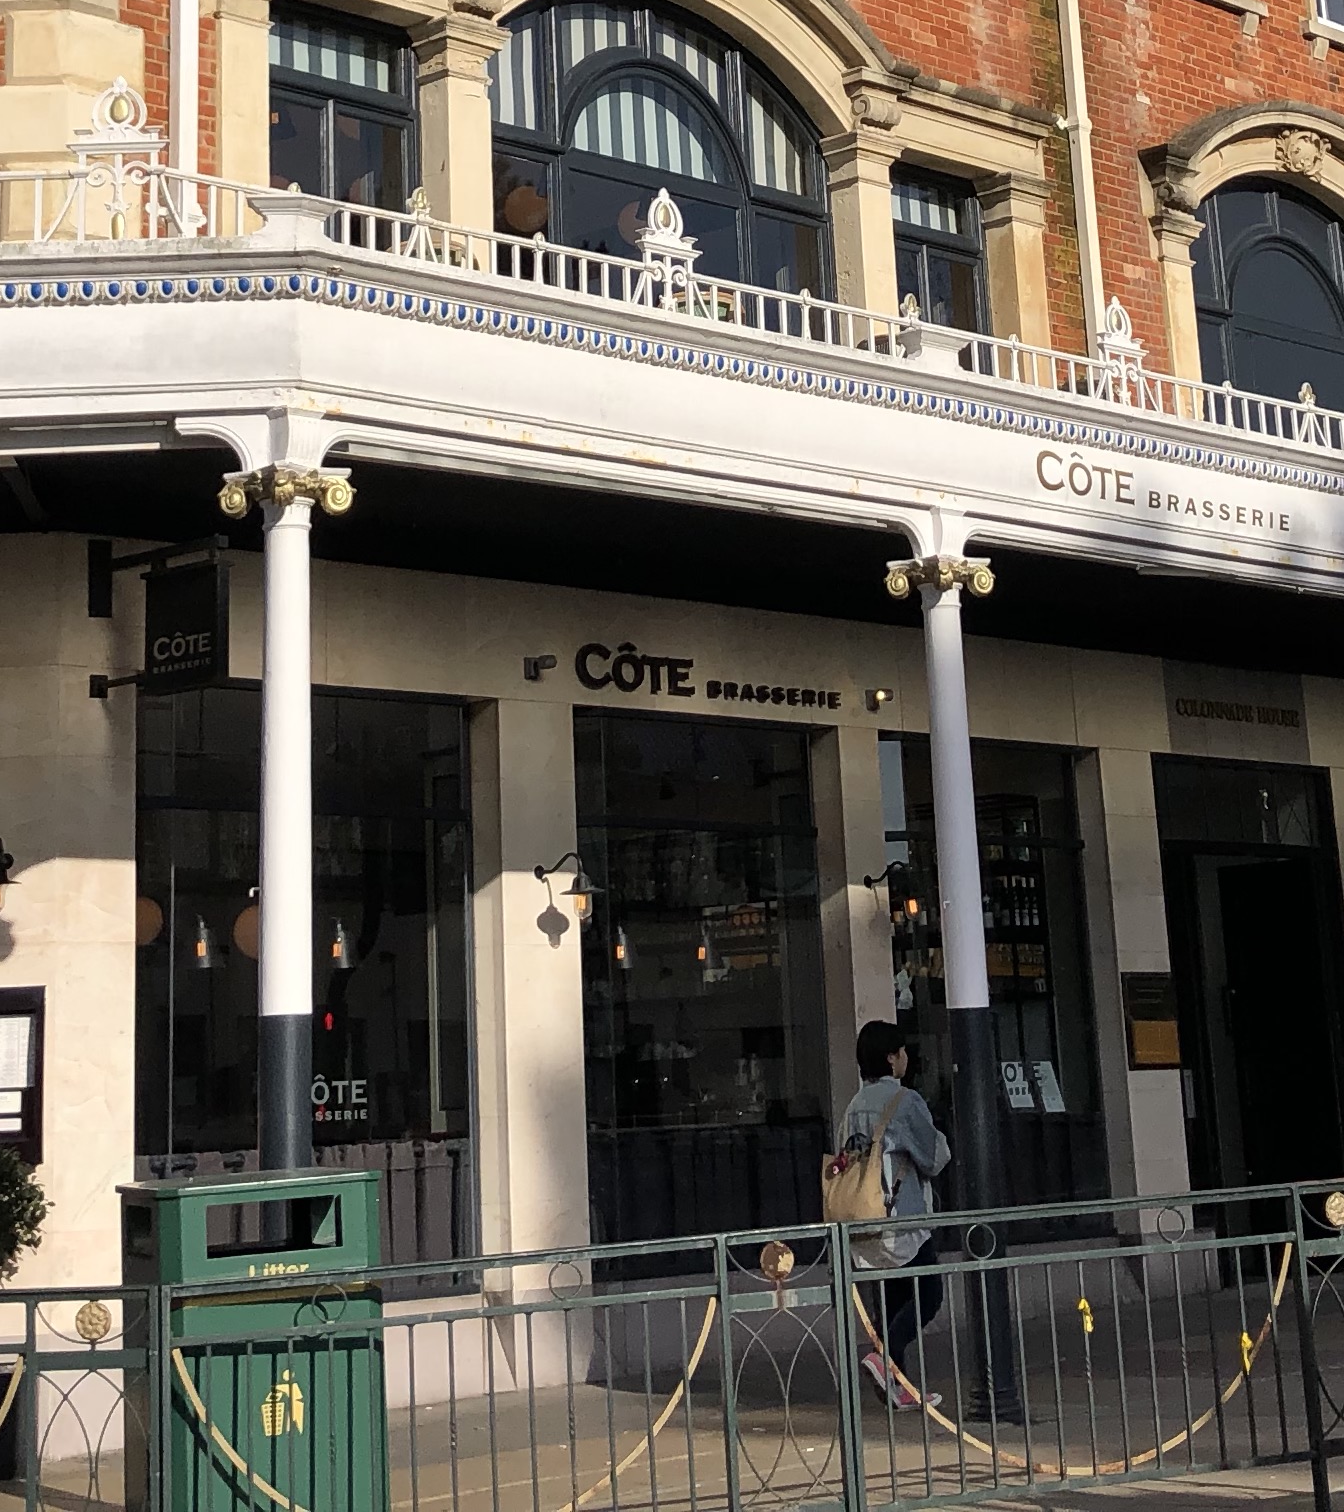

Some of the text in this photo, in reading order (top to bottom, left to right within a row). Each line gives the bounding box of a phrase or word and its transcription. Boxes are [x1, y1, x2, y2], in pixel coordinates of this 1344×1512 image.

[1036, 450, 1291, 532] CÔTE BRASSERIE
[153, 632, 212, 660] CÔTE
[575, 642, 842, 709] CÔTE BRASSERIE
[1257, 706, 1299, 728] HOUSE
[311, 1074, 368, 1104] ÔTE
[312, 1108, 368, 1122] SSERIE
